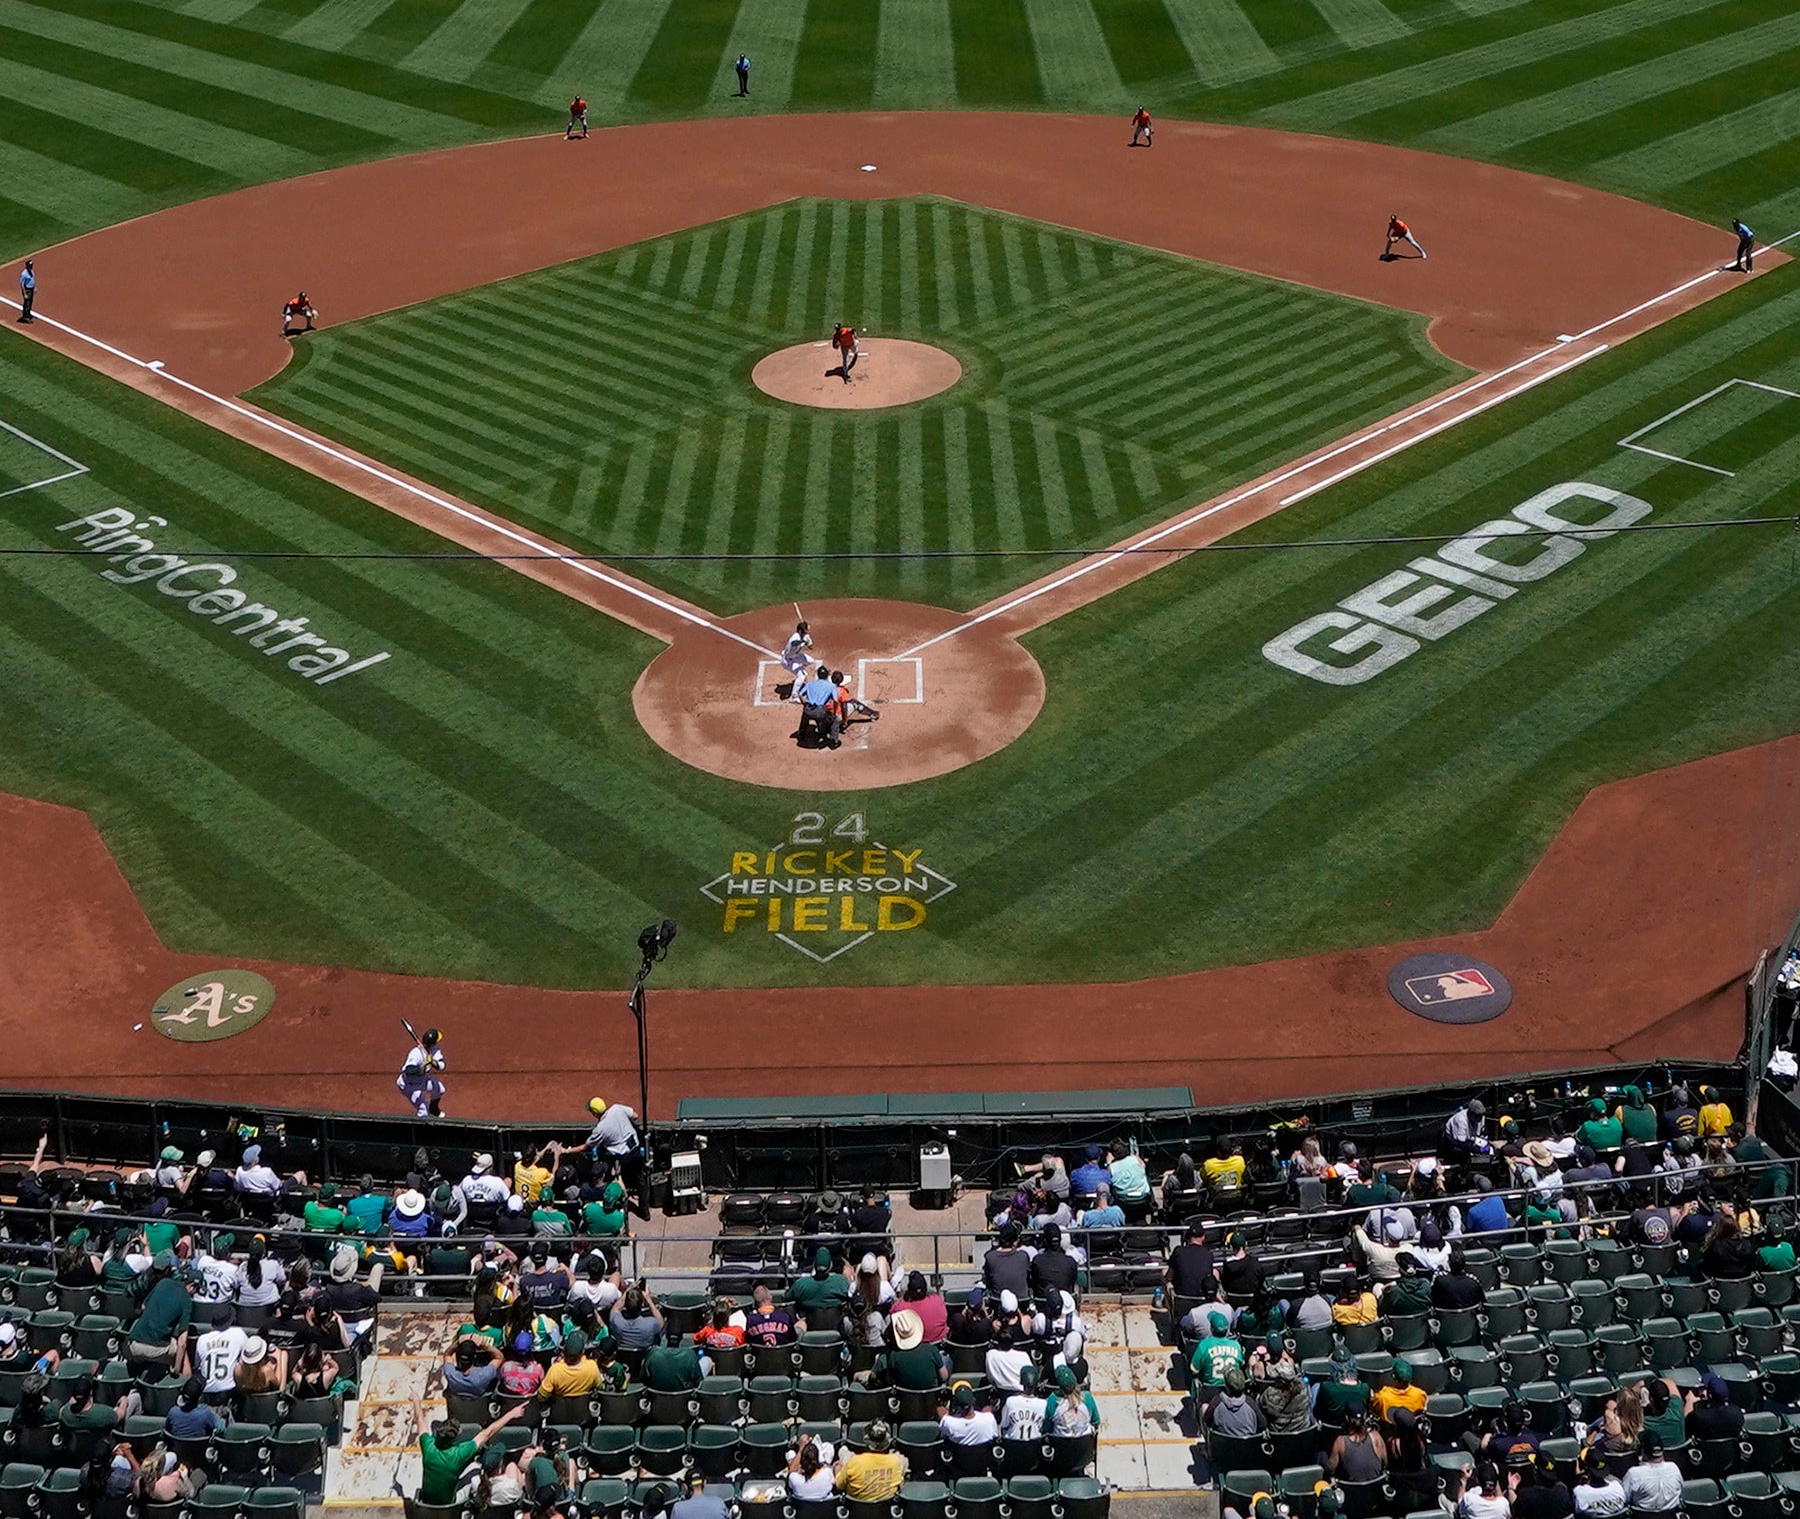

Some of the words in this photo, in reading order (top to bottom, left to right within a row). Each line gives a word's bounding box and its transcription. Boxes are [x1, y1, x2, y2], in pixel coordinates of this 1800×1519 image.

[55, 505, 393, 686] RingCentral
[1261, 481, 1654, 686] GEICO
[789, 809, 869, 846] 24
[730, 848, 924, 876] RICKEY
[727, 875, 929, 895] HENDERSON
[723, 895, 928, 934] FIELD
[160, 981, 257, 1028] A's
[204, 1353, 230, 1380] 15
